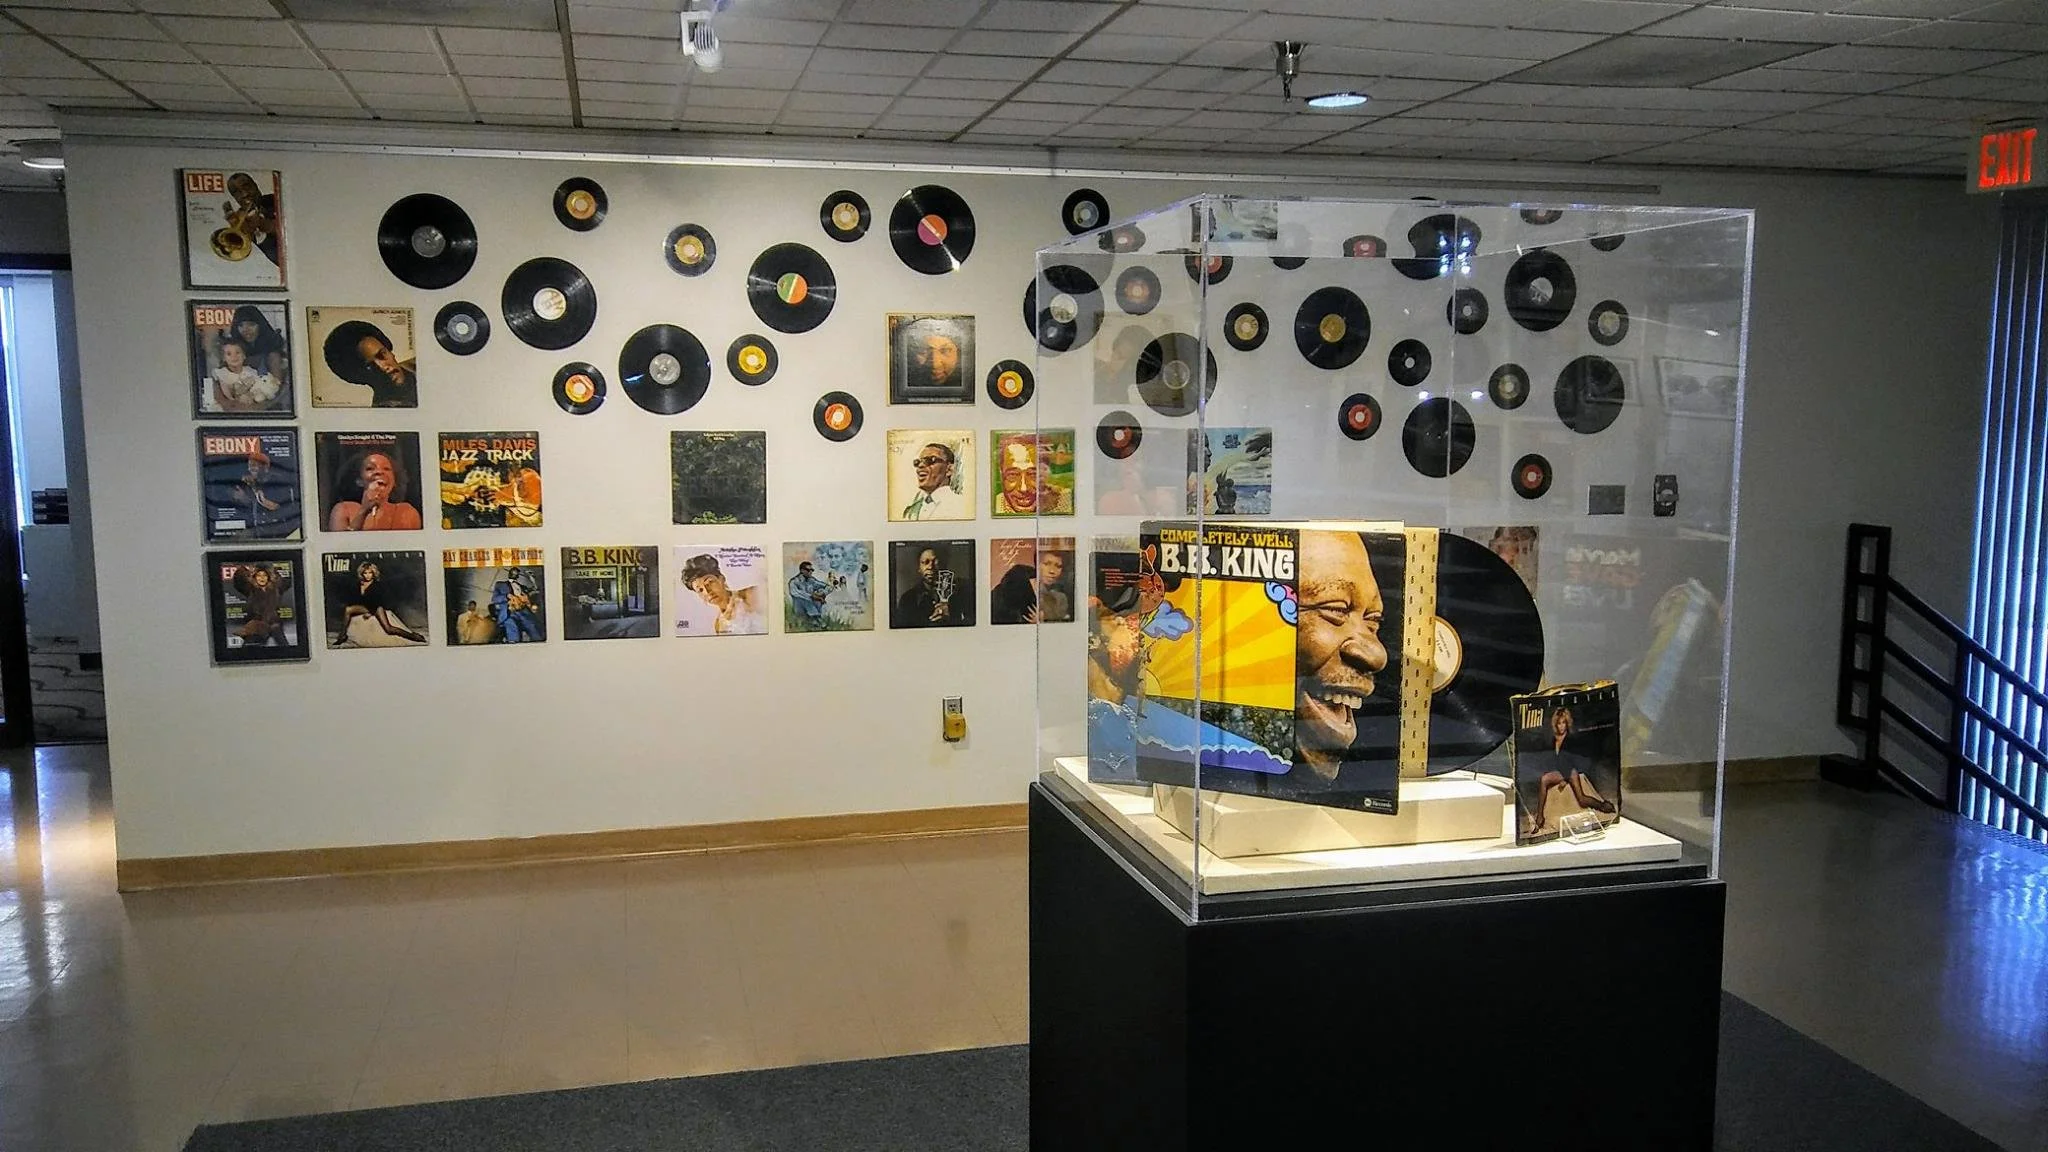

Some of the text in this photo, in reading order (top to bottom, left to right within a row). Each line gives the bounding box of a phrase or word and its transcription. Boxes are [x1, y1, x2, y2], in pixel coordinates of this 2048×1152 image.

[1978, 128, 2038, 190] EXIT
[187, 174, 223, 191] LIFE
[196, 308, 236, 326] EBON
[206, 436, 259, 453] EBONY
[443, 438, 537, 451] MILES DAVIS
[442, 449, 535, 462] JAZZ TRACK
[1252, 532, 1294, 549] WELL
[324, 554, 350, 572] Tina
[570, 548, 600, 565] B.B.
[1160, 542, 1294, 580] B.B. KING
[1519, 703, 1544, 730] Tina
